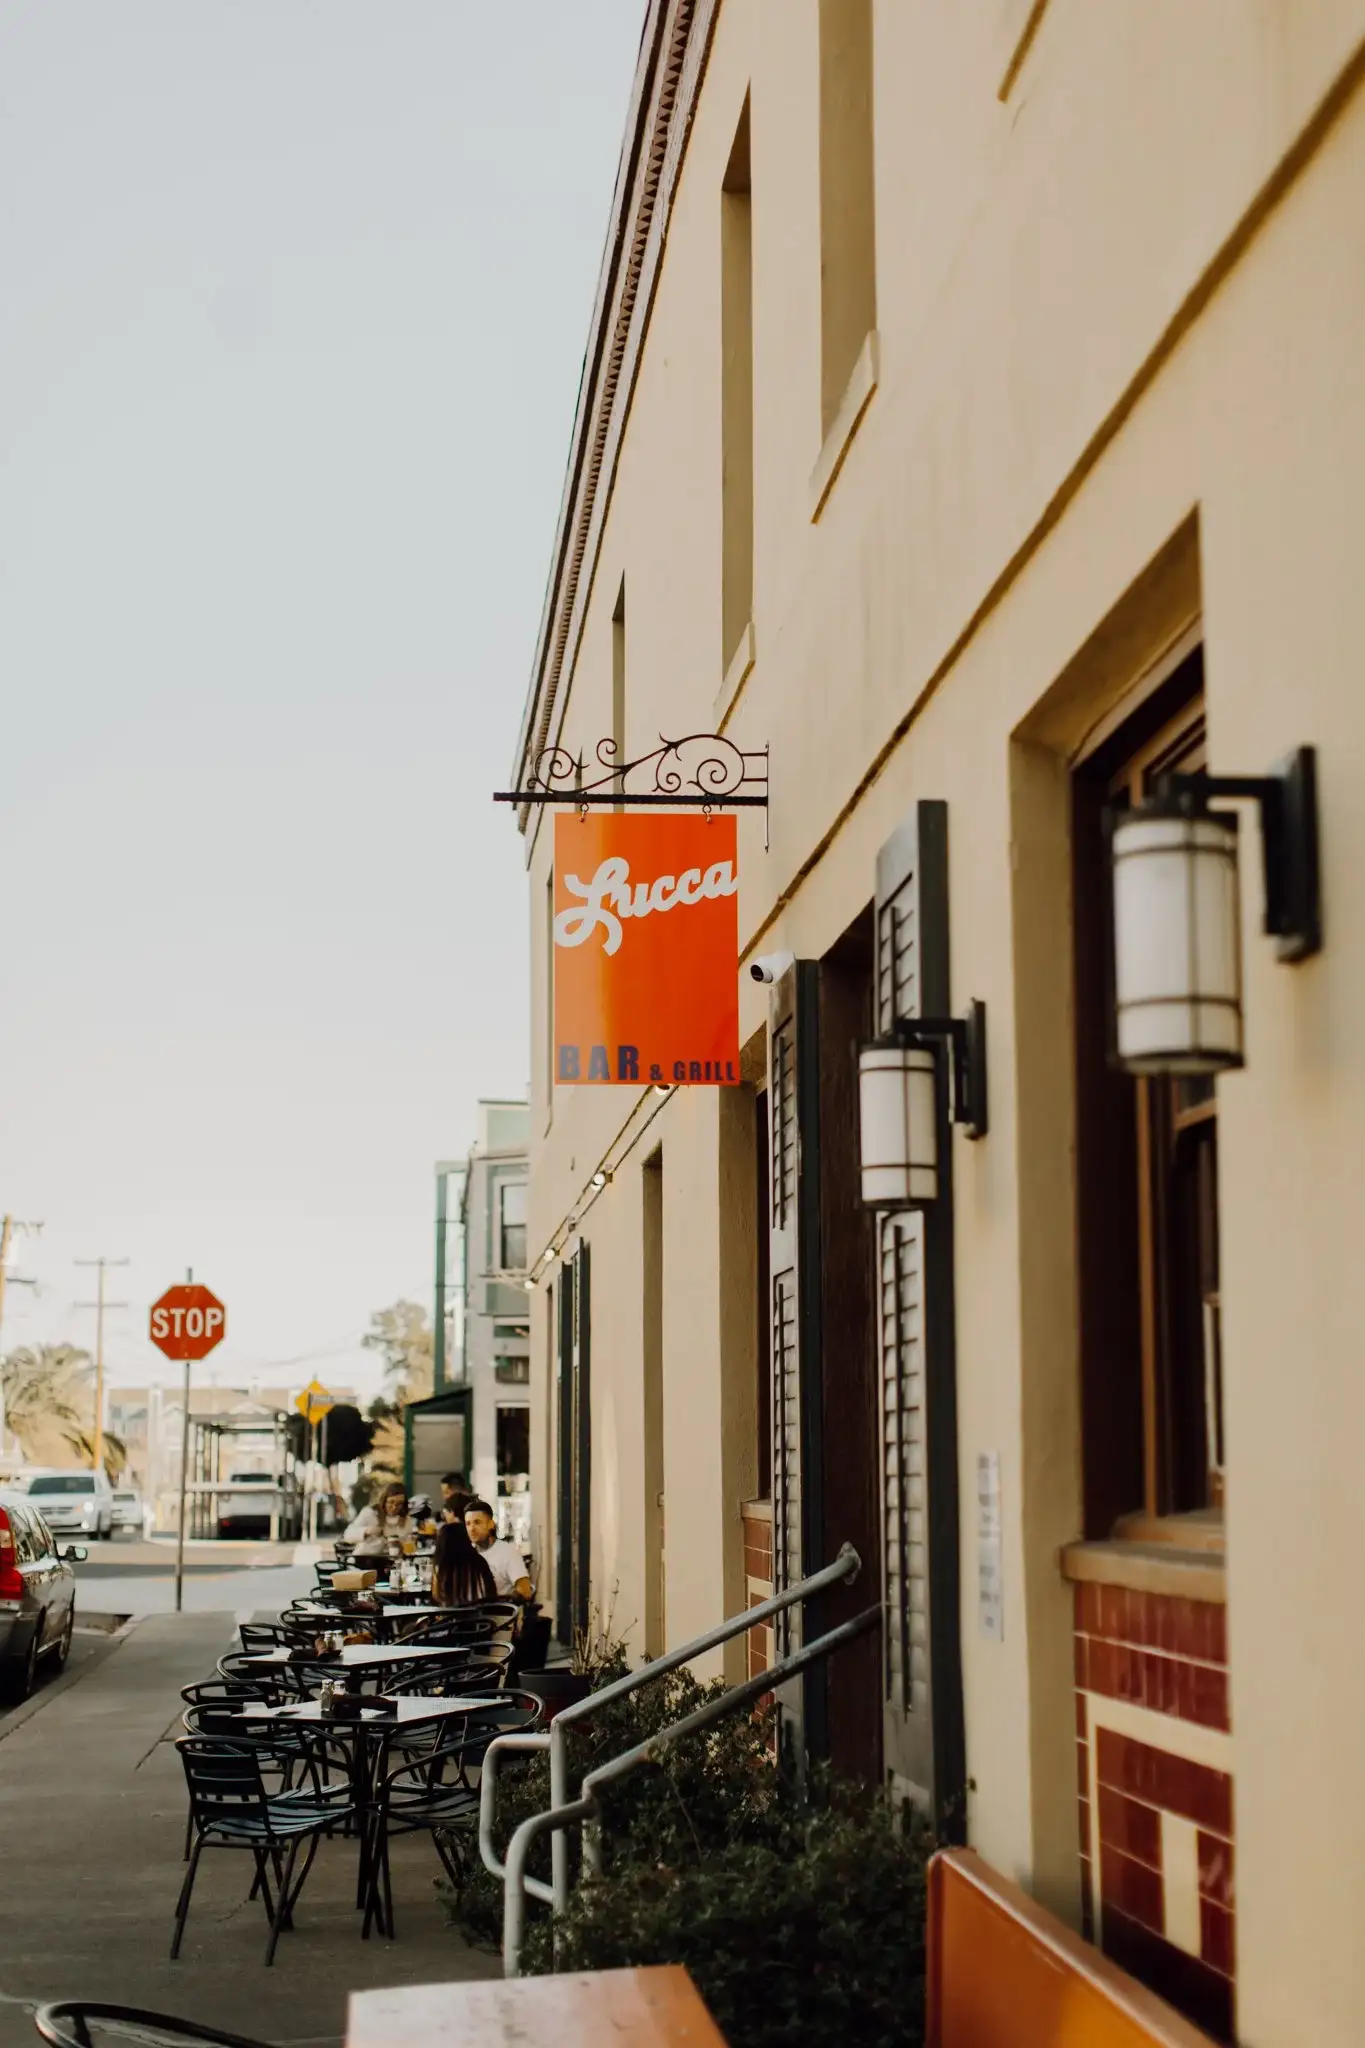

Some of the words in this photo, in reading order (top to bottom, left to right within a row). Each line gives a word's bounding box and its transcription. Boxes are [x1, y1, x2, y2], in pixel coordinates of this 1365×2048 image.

[555, 857, 738, 956] Lucca
[559, 1045, 640, 1081] BAR
[649, 1063, 663, 1081] &
[673, 1060, 736, 1081] GRILL
[152, 1307, 223, 1338] STOP
